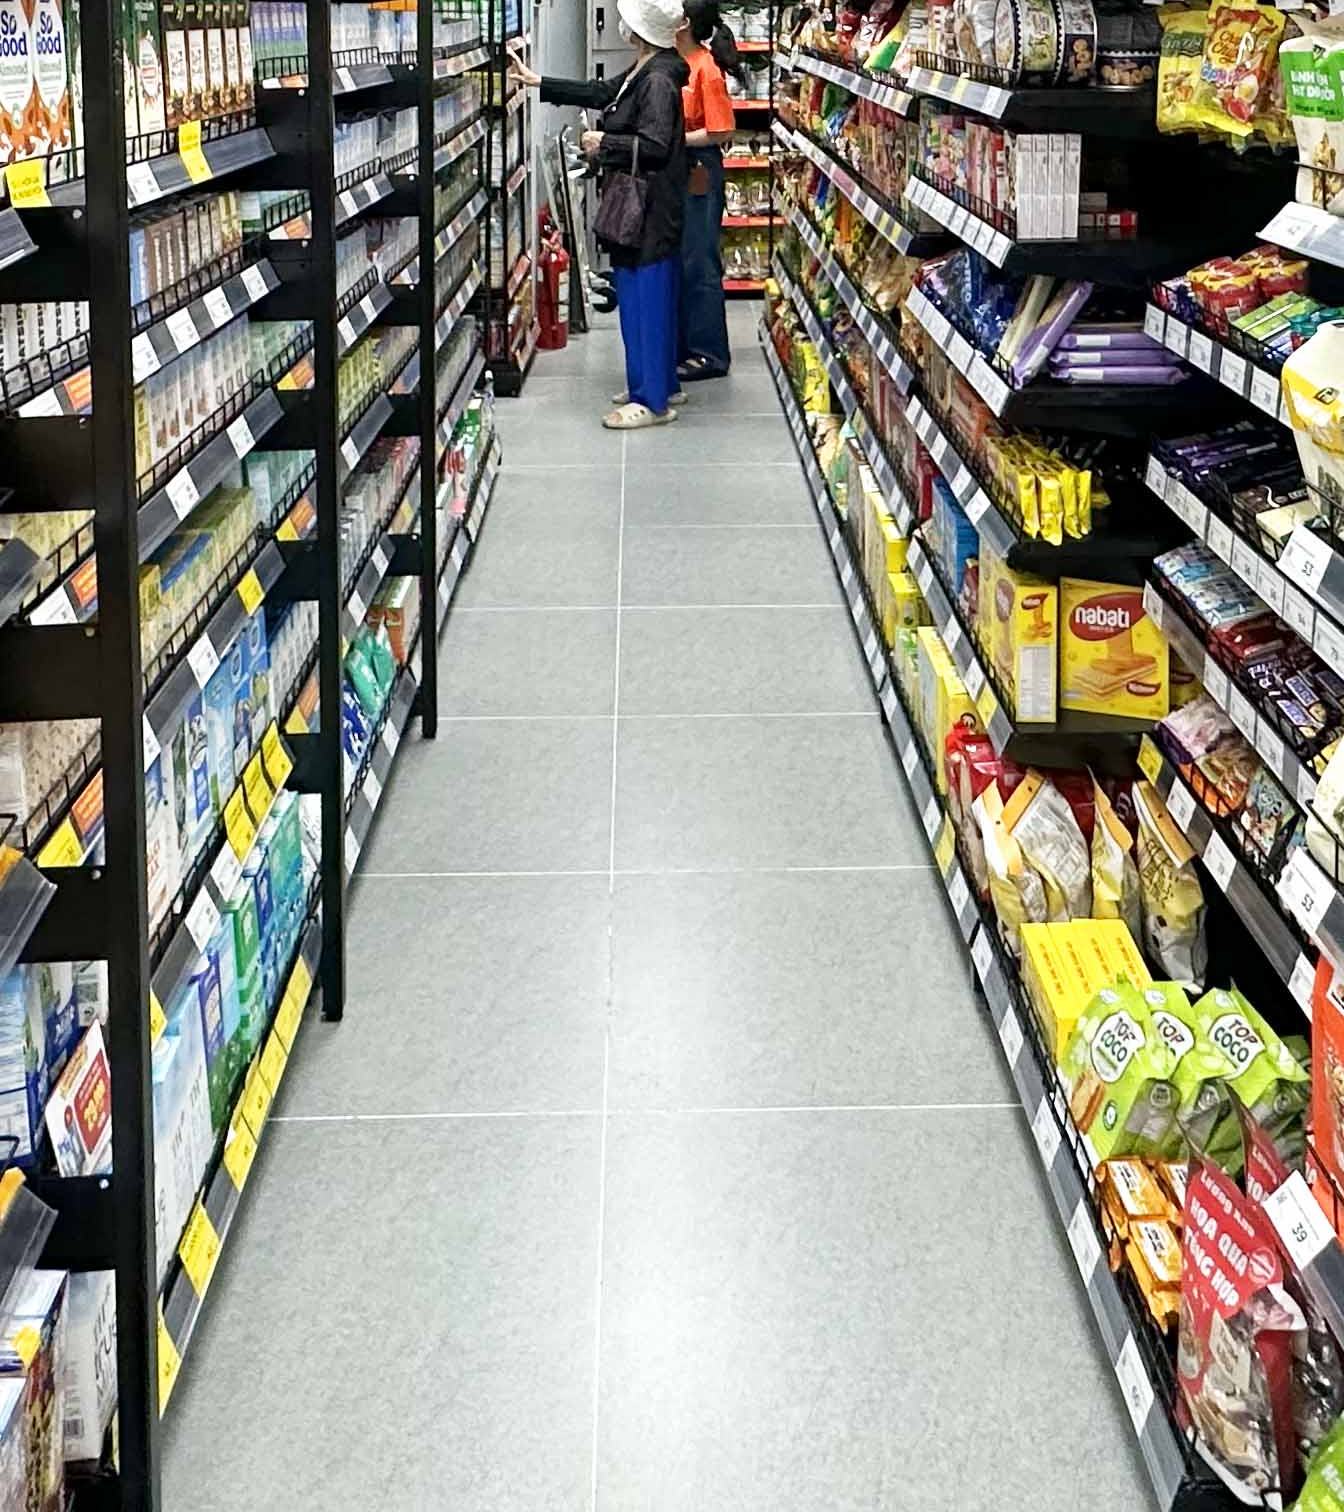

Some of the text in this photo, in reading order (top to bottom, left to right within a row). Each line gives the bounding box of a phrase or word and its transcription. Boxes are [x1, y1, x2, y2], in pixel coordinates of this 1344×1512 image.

[0, 11, 17, 35] So
[1075, 605, 1131, 629] nabati
[1228, 1018, 1258, 1045] TOP
[1212, 1026, 1252, 1065] COCO
[1290, 1221, 1310, 1245] 39
